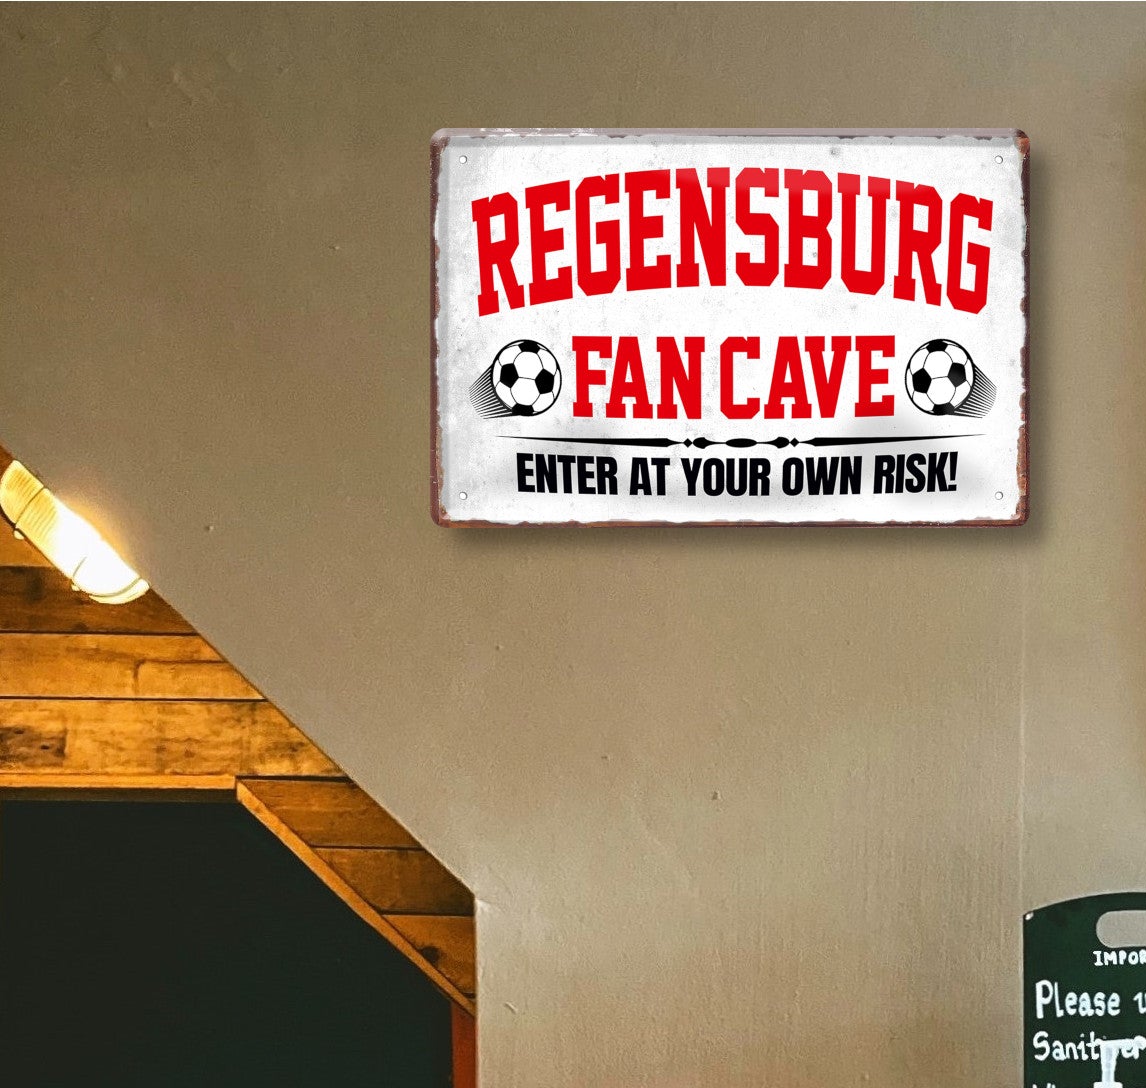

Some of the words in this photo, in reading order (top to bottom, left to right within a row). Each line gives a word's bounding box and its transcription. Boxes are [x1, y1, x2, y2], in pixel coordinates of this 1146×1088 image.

[472, 166, 994, 317] REGENSBURG
[572, 336, 705, 419] FAN
[719, 334, 896, 420] CAVE
[516, 452, 618, 494] ENTER
[629, 457, 671, 497] AT
[680, 458, 771, 498] YOUR
[781, 456, 863, 497] OWN
[873, 451, 959, 495] RISK!
[1035, 979, 1121, 1019] Please
